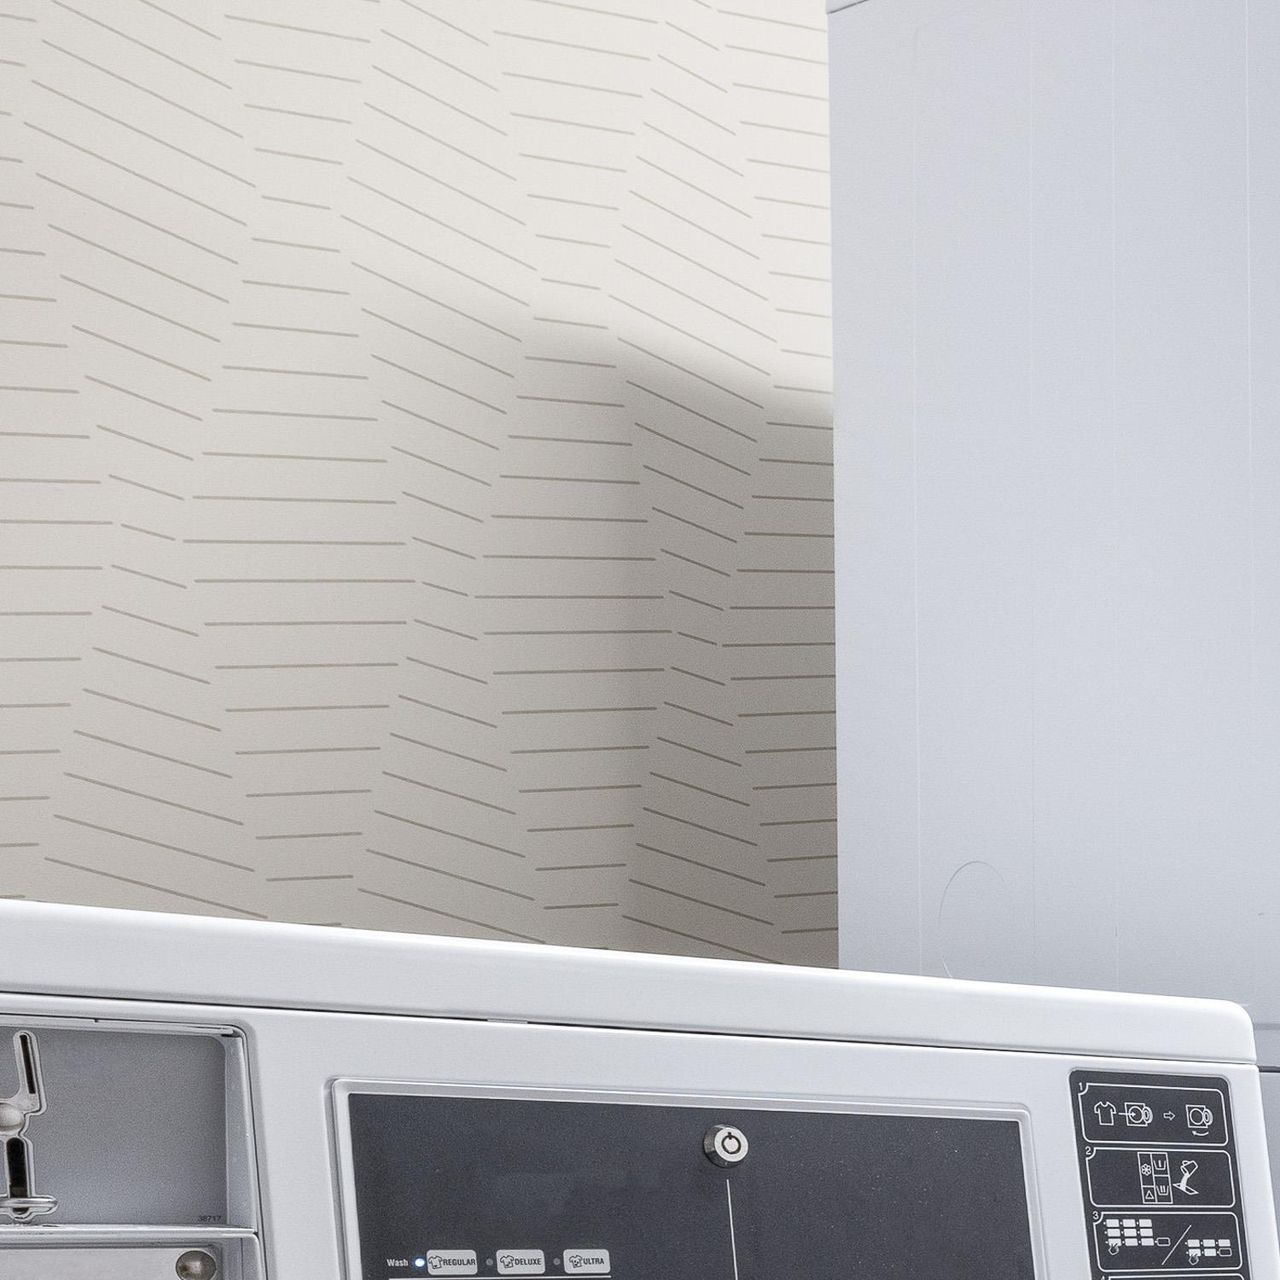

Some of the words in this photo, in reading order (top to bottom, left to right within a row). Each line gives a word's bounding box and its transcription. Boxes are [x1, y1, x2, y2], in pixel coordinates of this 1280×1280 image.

[1085, 1146, 1091, 1155] 2
[1092, 1211, 1099, 1219] 3
[387, 1259, 409, 1267] Wash
